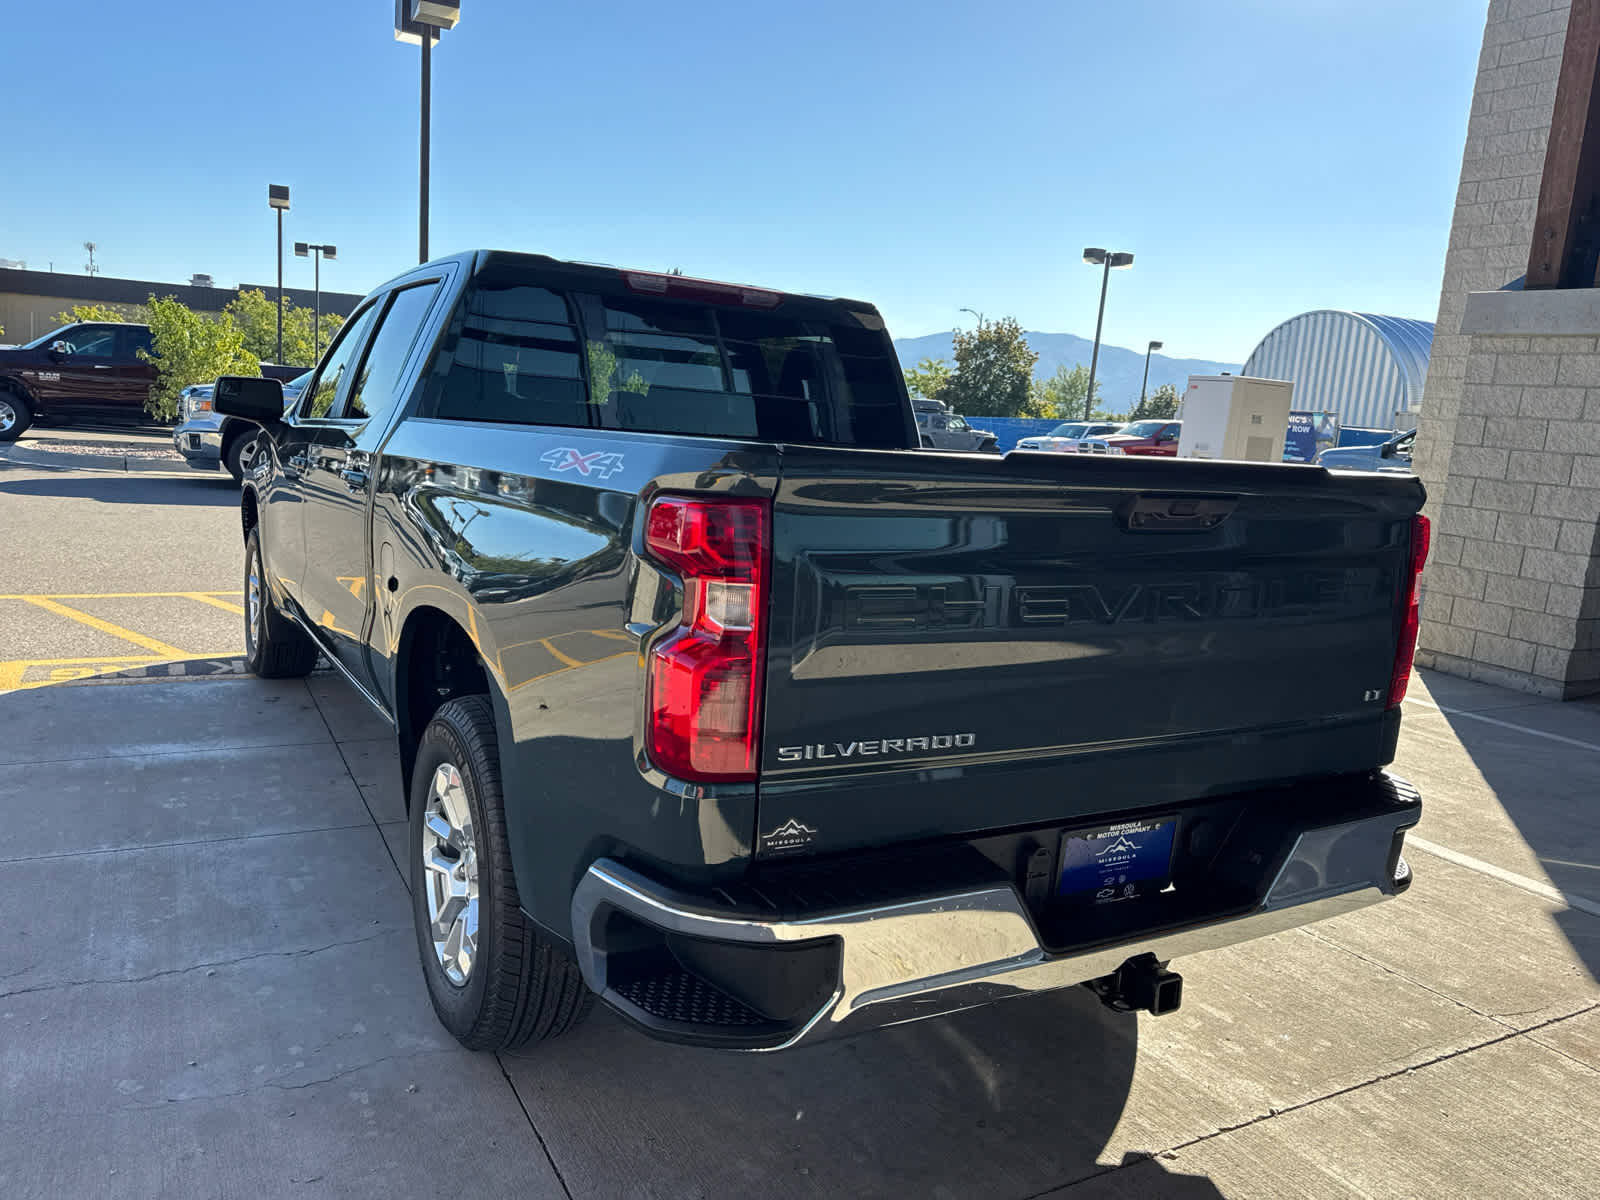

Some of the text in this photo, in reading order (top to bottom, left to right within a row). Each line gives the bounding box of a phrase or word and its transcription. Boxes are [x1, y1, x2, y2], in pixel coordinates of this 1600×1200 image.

[778, 733, 976, 761] SILVERADO
[1110, 821, 1141, 831] MISSOULA
[1097, 826, 1151, 839] MOTOR COMPANY
[767, 837, 811, 846] MISSOULA
[1098, 854, 1136, 863] MISSOULA
